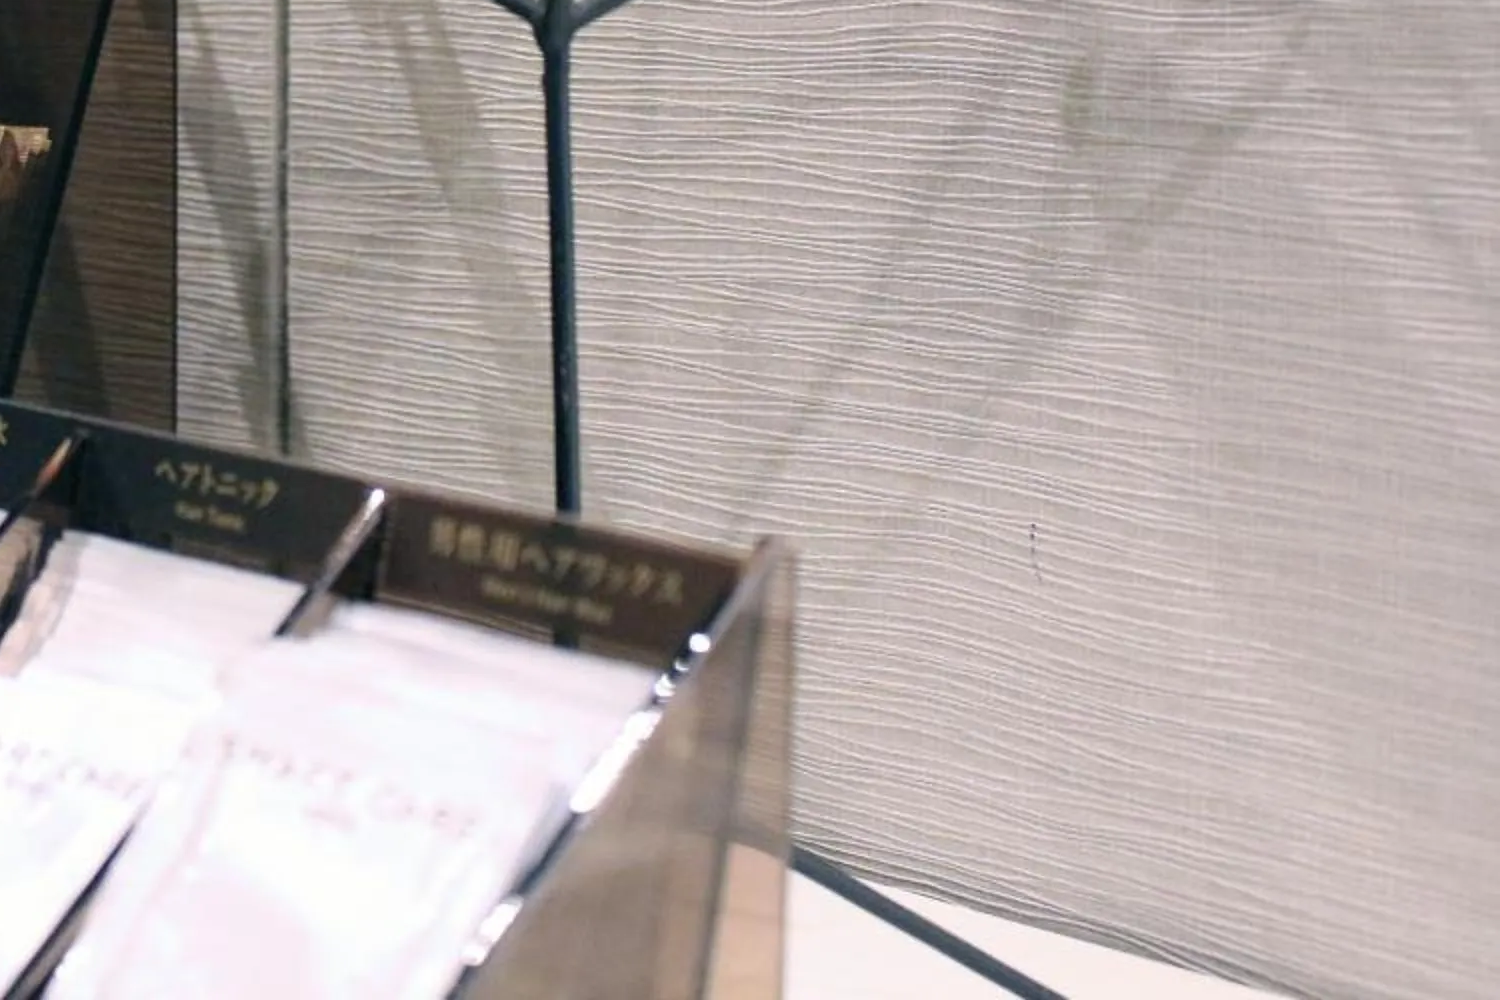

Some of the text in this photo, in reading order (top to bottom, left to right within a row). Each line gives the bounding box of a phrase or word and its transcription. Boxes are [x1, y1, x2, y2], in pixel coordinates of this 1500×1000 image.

[155, 459, 279, 510] ヘアトニック
